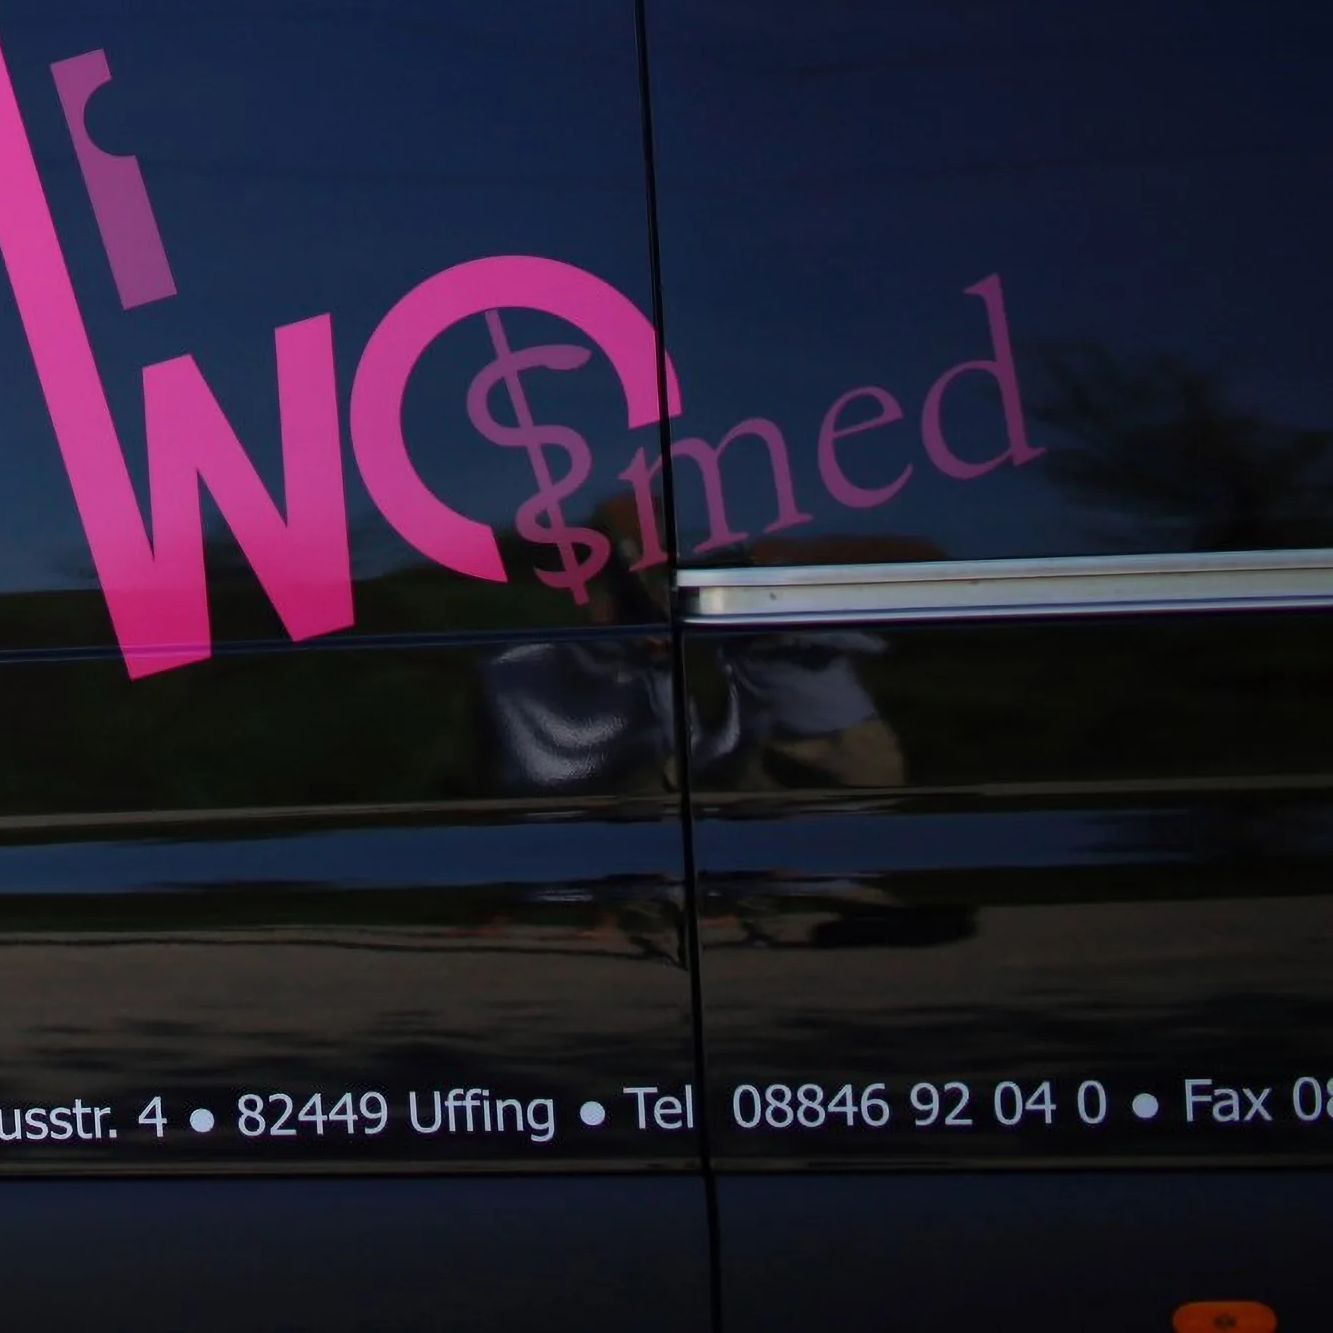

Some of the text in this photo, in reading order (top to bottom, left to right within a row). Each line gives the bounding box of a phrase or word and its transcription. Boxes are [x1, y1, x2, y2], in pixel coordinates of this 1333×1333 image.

[138, 1096, 168, 1138] 4
[237, 1091, 388, 1137] 82449
[409, 1084, 555, 1142] Uffing
[622, 1084, 695, 1129] Tel
[733, 1083, 890, 1128] 08846
[910, 1082, 972, 1126] 92
[994, 1081, 1057, 1125] 04
[1077, 1080, 1107, 1124] 0
[1185, 1078, 1272, 1122] Fax
[1293, 1076, 1333, 1120] 0
